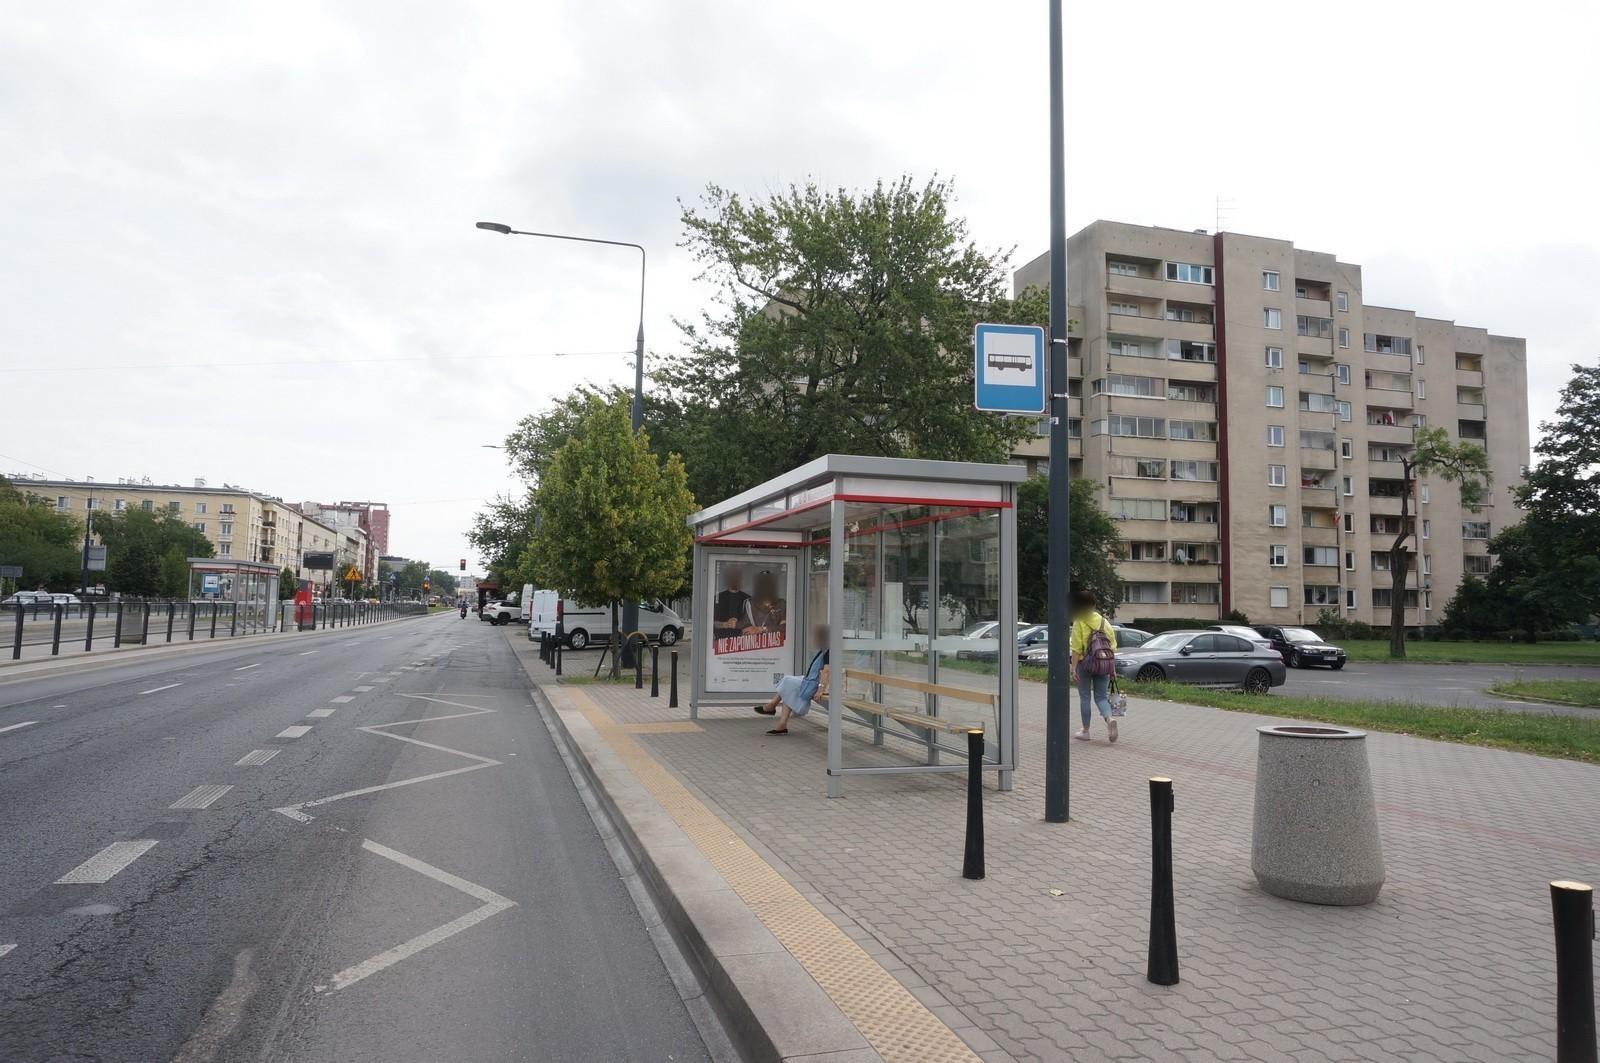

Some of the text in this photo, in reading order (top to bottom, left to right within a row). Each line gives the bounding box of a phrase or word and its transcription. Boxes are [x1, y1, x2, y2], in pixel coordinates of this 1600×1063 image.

[718, 632, 780, 653] NIE ZAPOMNIJ O NAS
